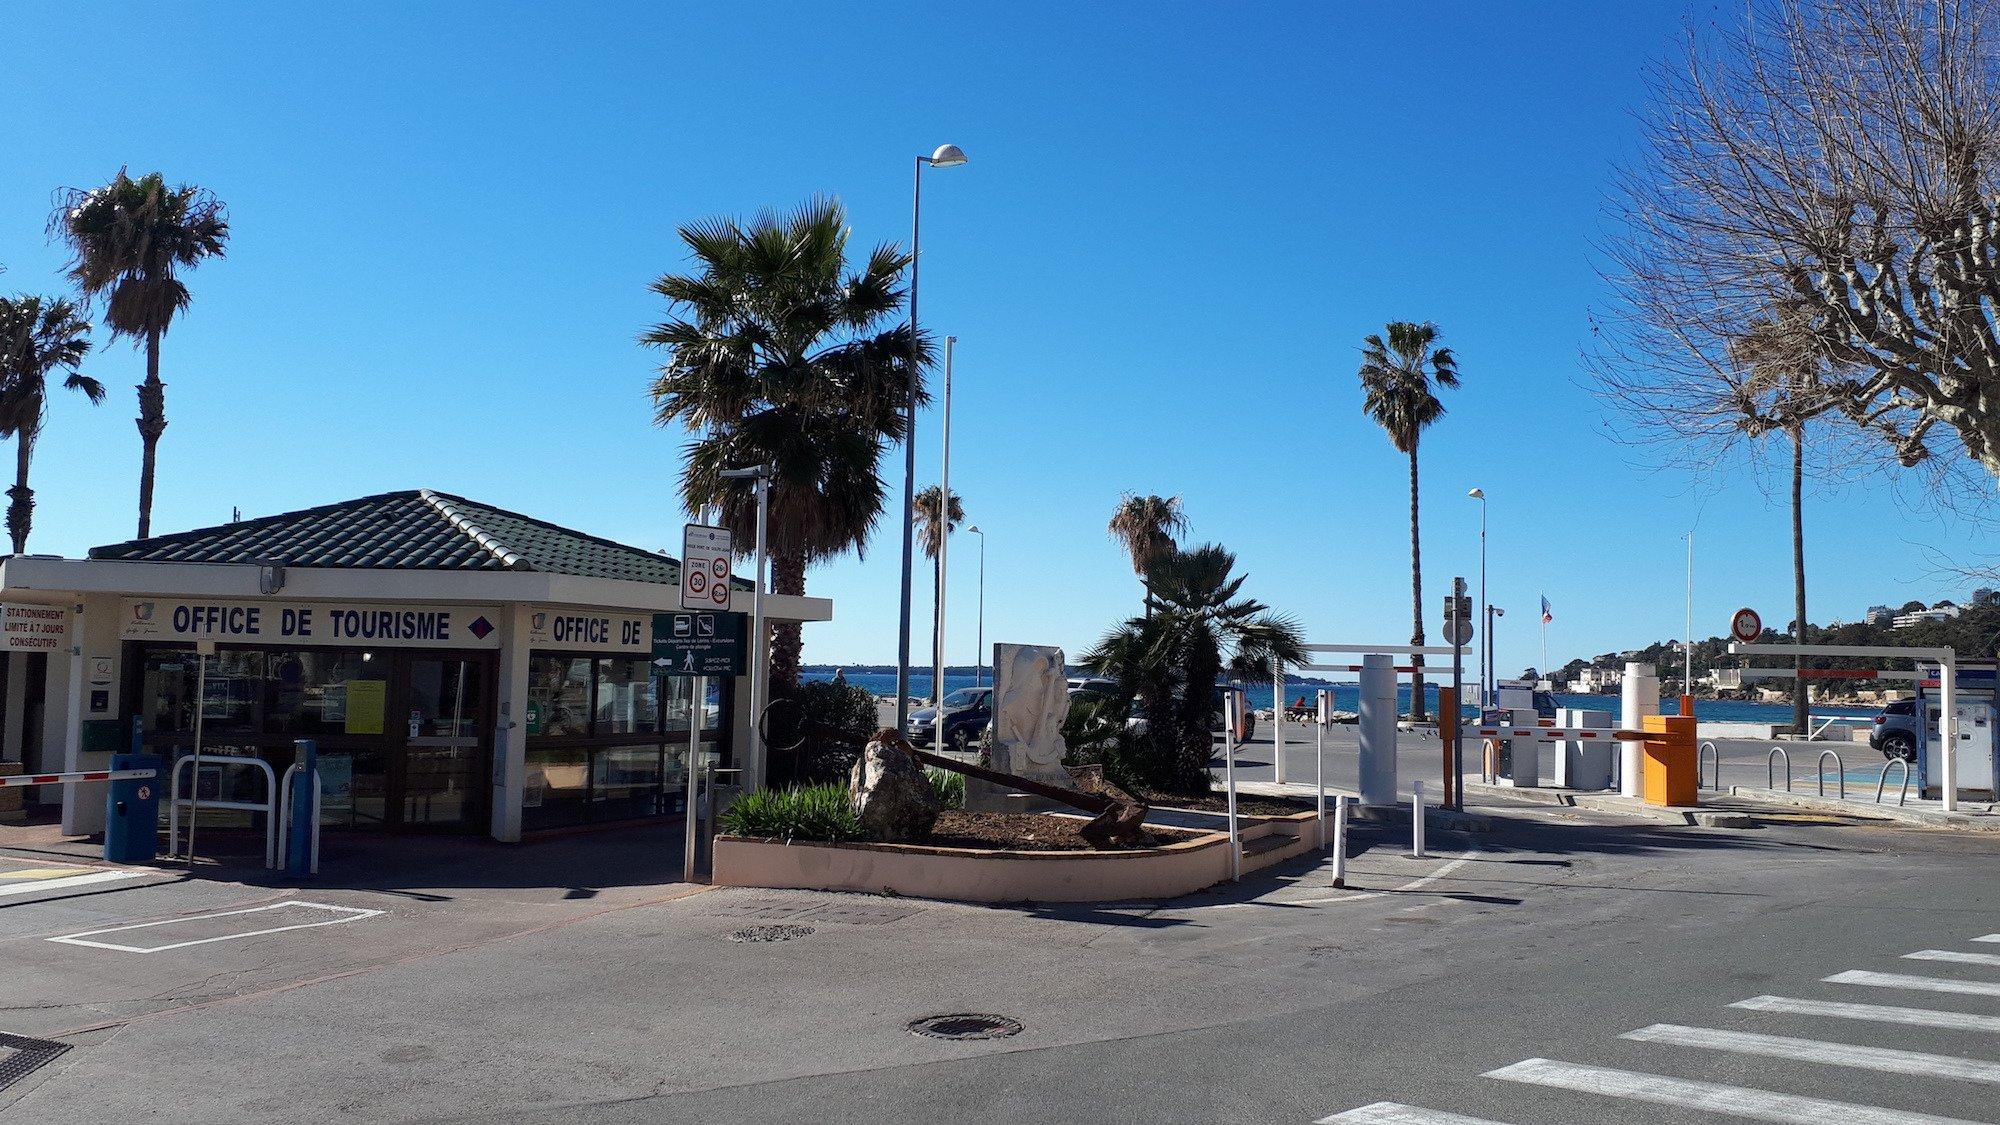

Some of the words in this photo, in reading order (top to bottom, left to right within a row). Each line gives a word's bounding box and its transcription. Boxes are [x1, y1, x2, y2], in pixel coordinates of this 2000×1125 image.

[694, 578, 702, 586] 30
[6, 607, 64, 620] STATIONNEMENT
[4, 620, 28, 632] LIMITÉ
[30, 620, 34, 632] À
[36, 624, 40, 632] 7
[42, 624, 64, 634] JOURS
[173, 605, 260, 634] OFFICE
[281, 608, 312, 637] DE
[330, 610, 450, 640] TOURISME
[554, 616, 610, 643] OFFICE
[622, 620, 641, 645] DE
[10, 636, 58, 648] CONSÉCUTIFS
